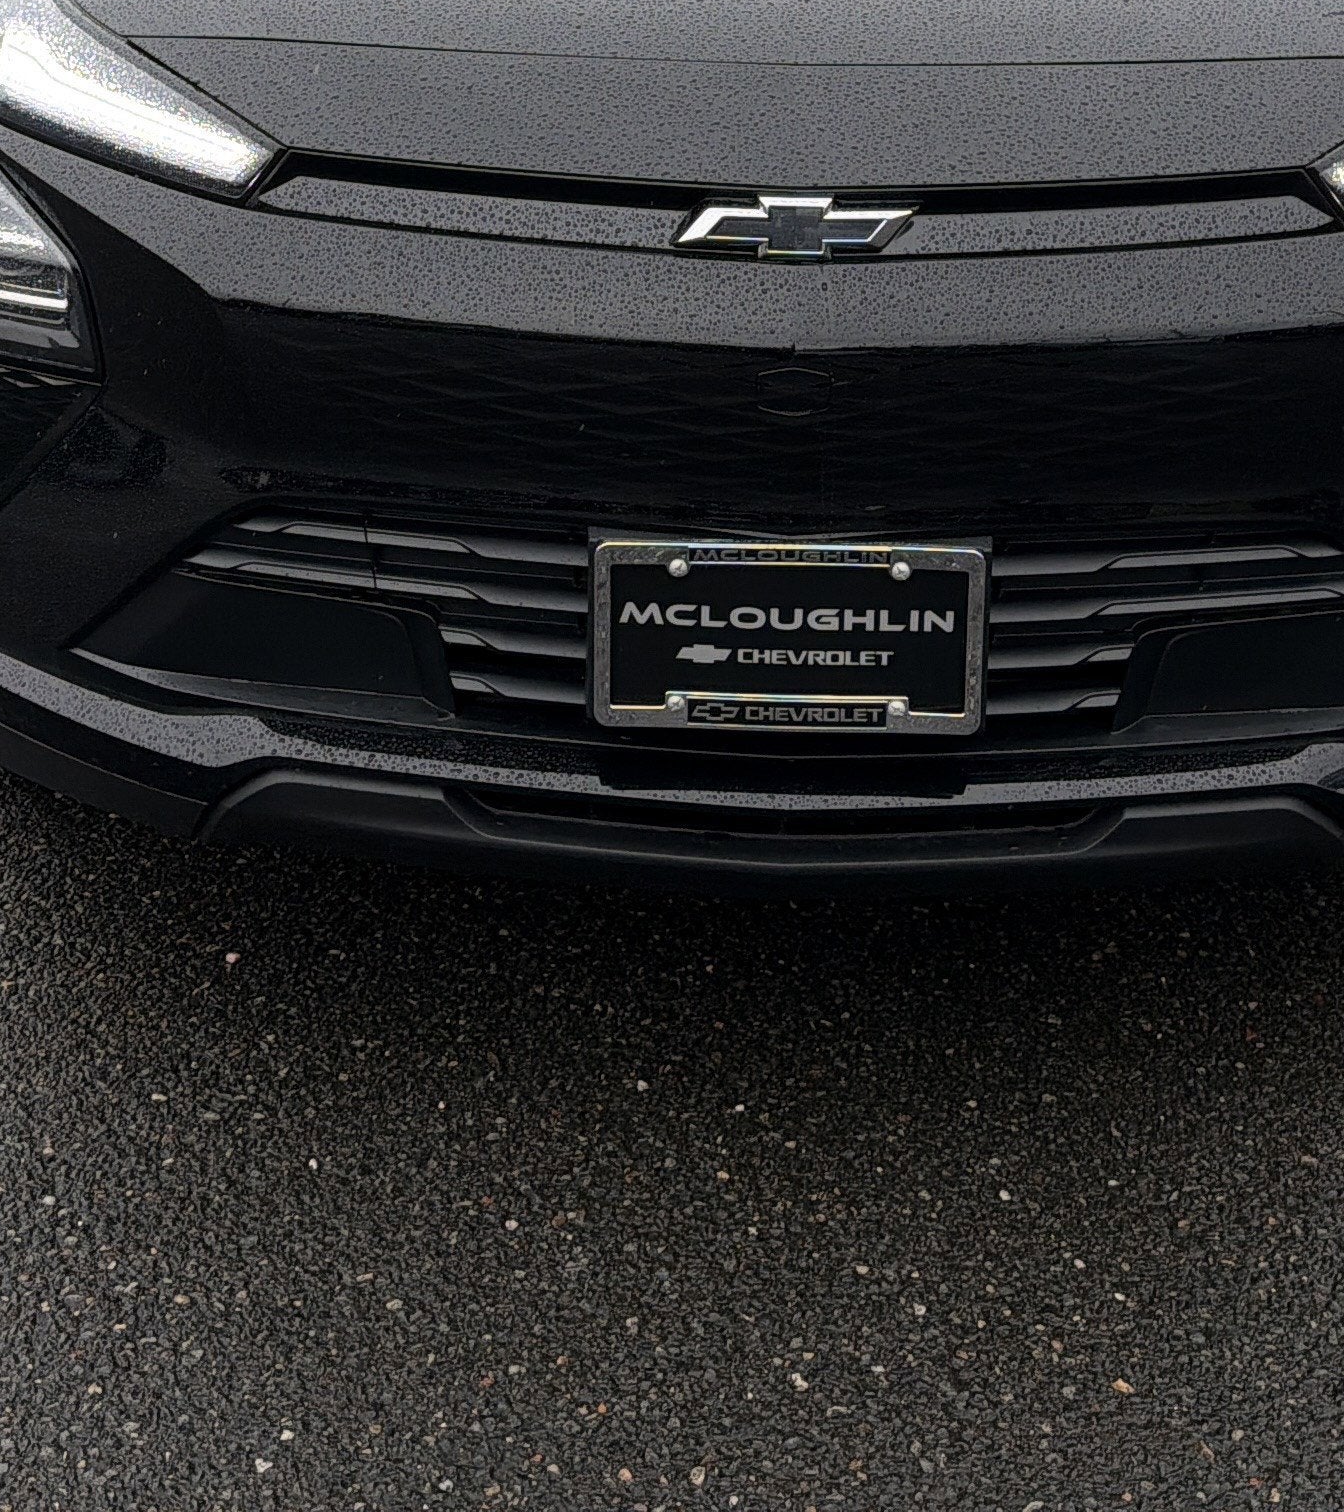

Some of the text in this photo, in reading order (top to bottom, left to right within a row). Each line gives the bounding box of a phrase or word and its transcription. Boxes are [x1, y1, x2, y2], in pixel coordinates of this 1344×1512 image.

[693, 548, 890, 564] MCLOUGHLIN
[618, 600, 955, 633] MCLOUGHLIN
[737, 648, 894, 666] CHEVROLET
[745, 706, 884, 724] CHEVROLET
